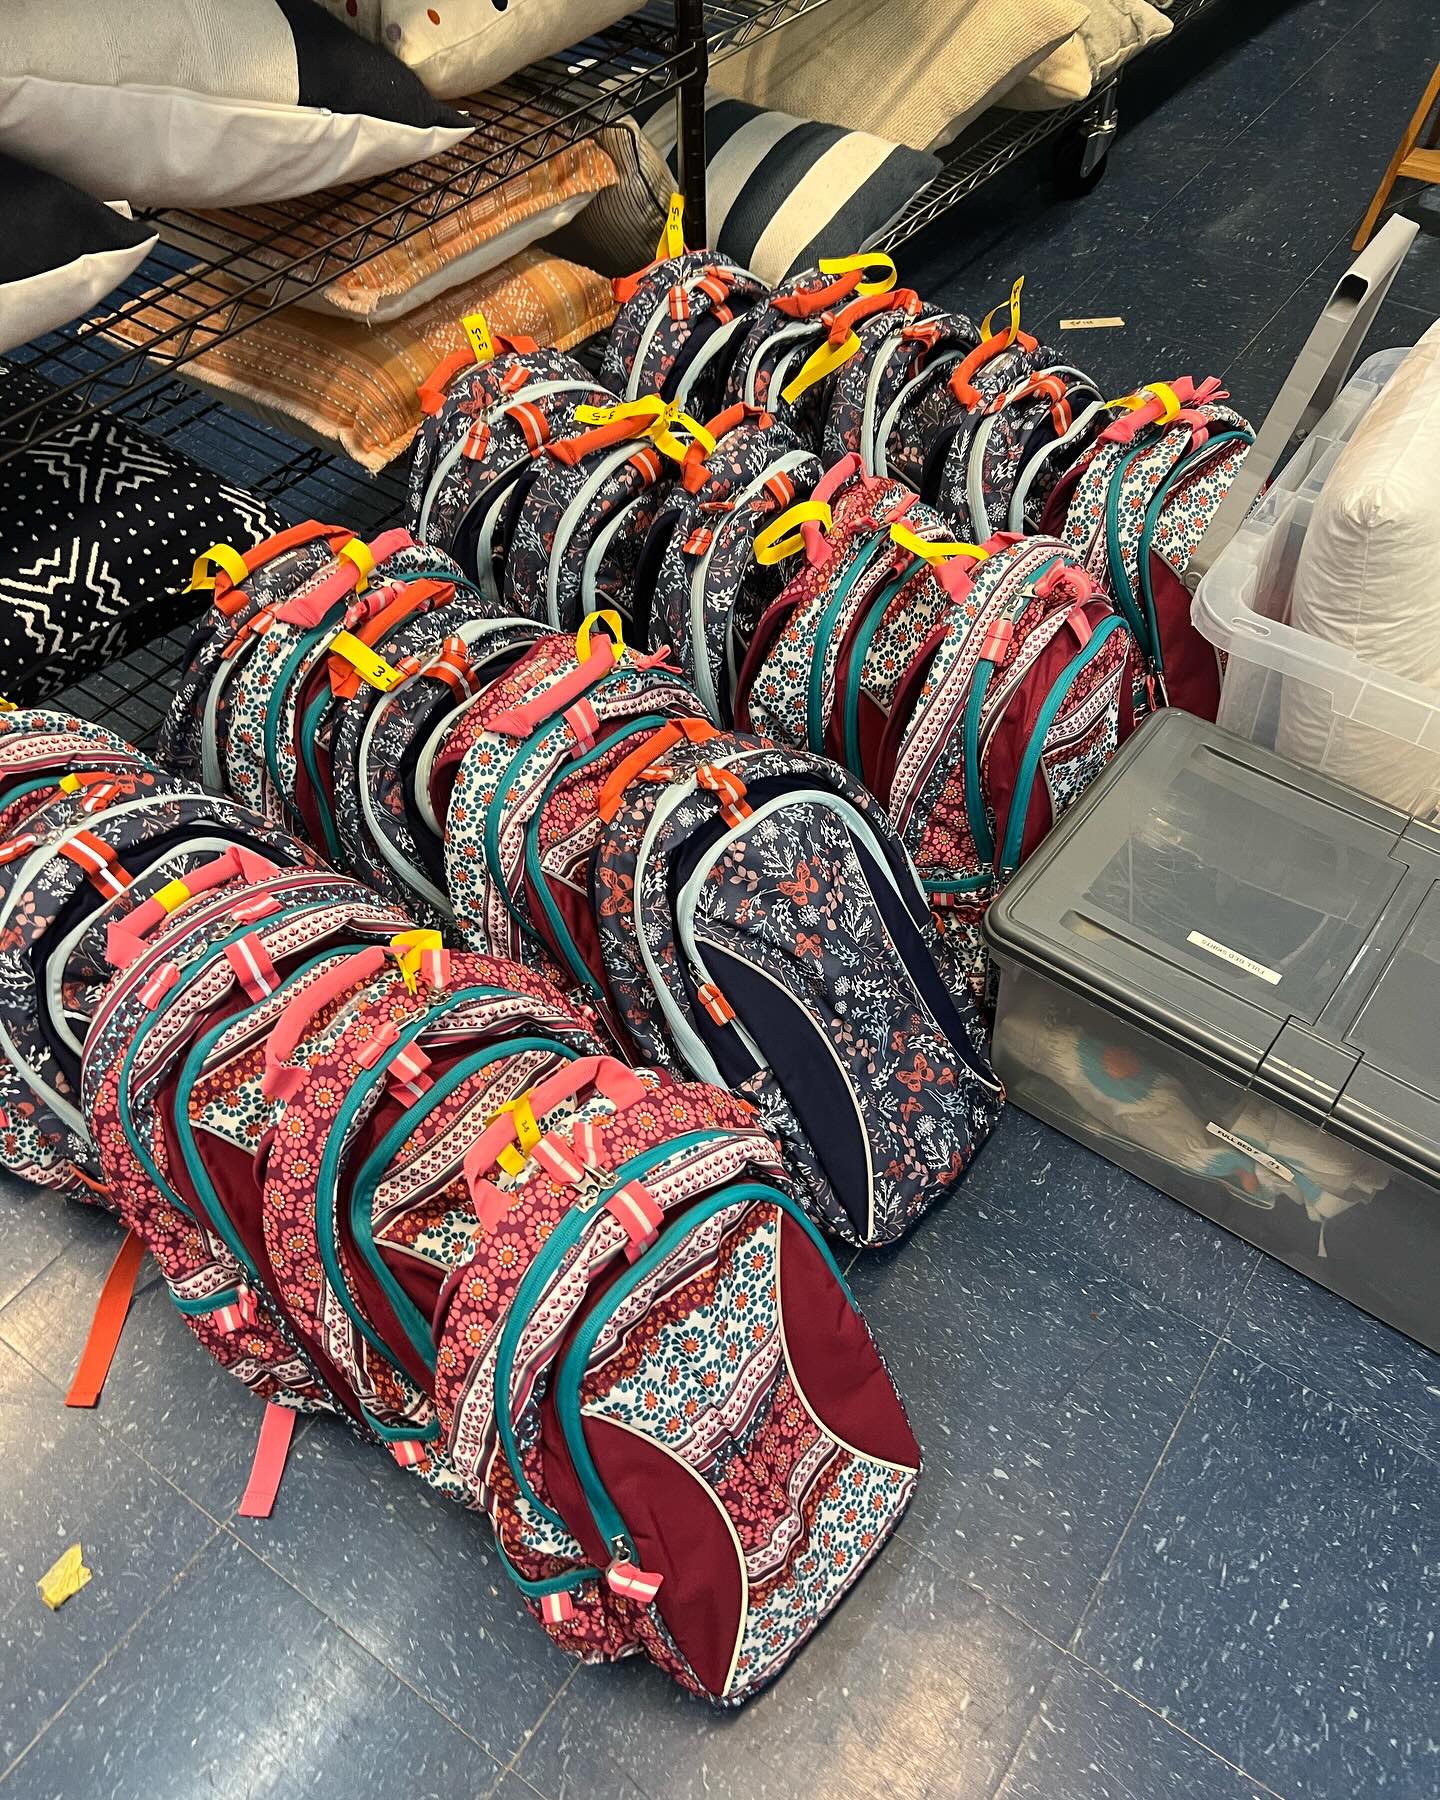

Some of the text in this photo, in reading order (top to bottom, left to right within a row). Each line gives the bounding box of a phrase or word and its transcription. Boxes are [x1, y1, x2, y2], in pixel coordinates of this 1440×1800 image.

[670, 207, 680, 231] 3-5
[471, 327, 488, 350] 3-5
[1228, 953, 1245, 964] BED
[1246, 961, 1266, 975] FULL
[1217, 1130, 1253, 1152] FULL BED
